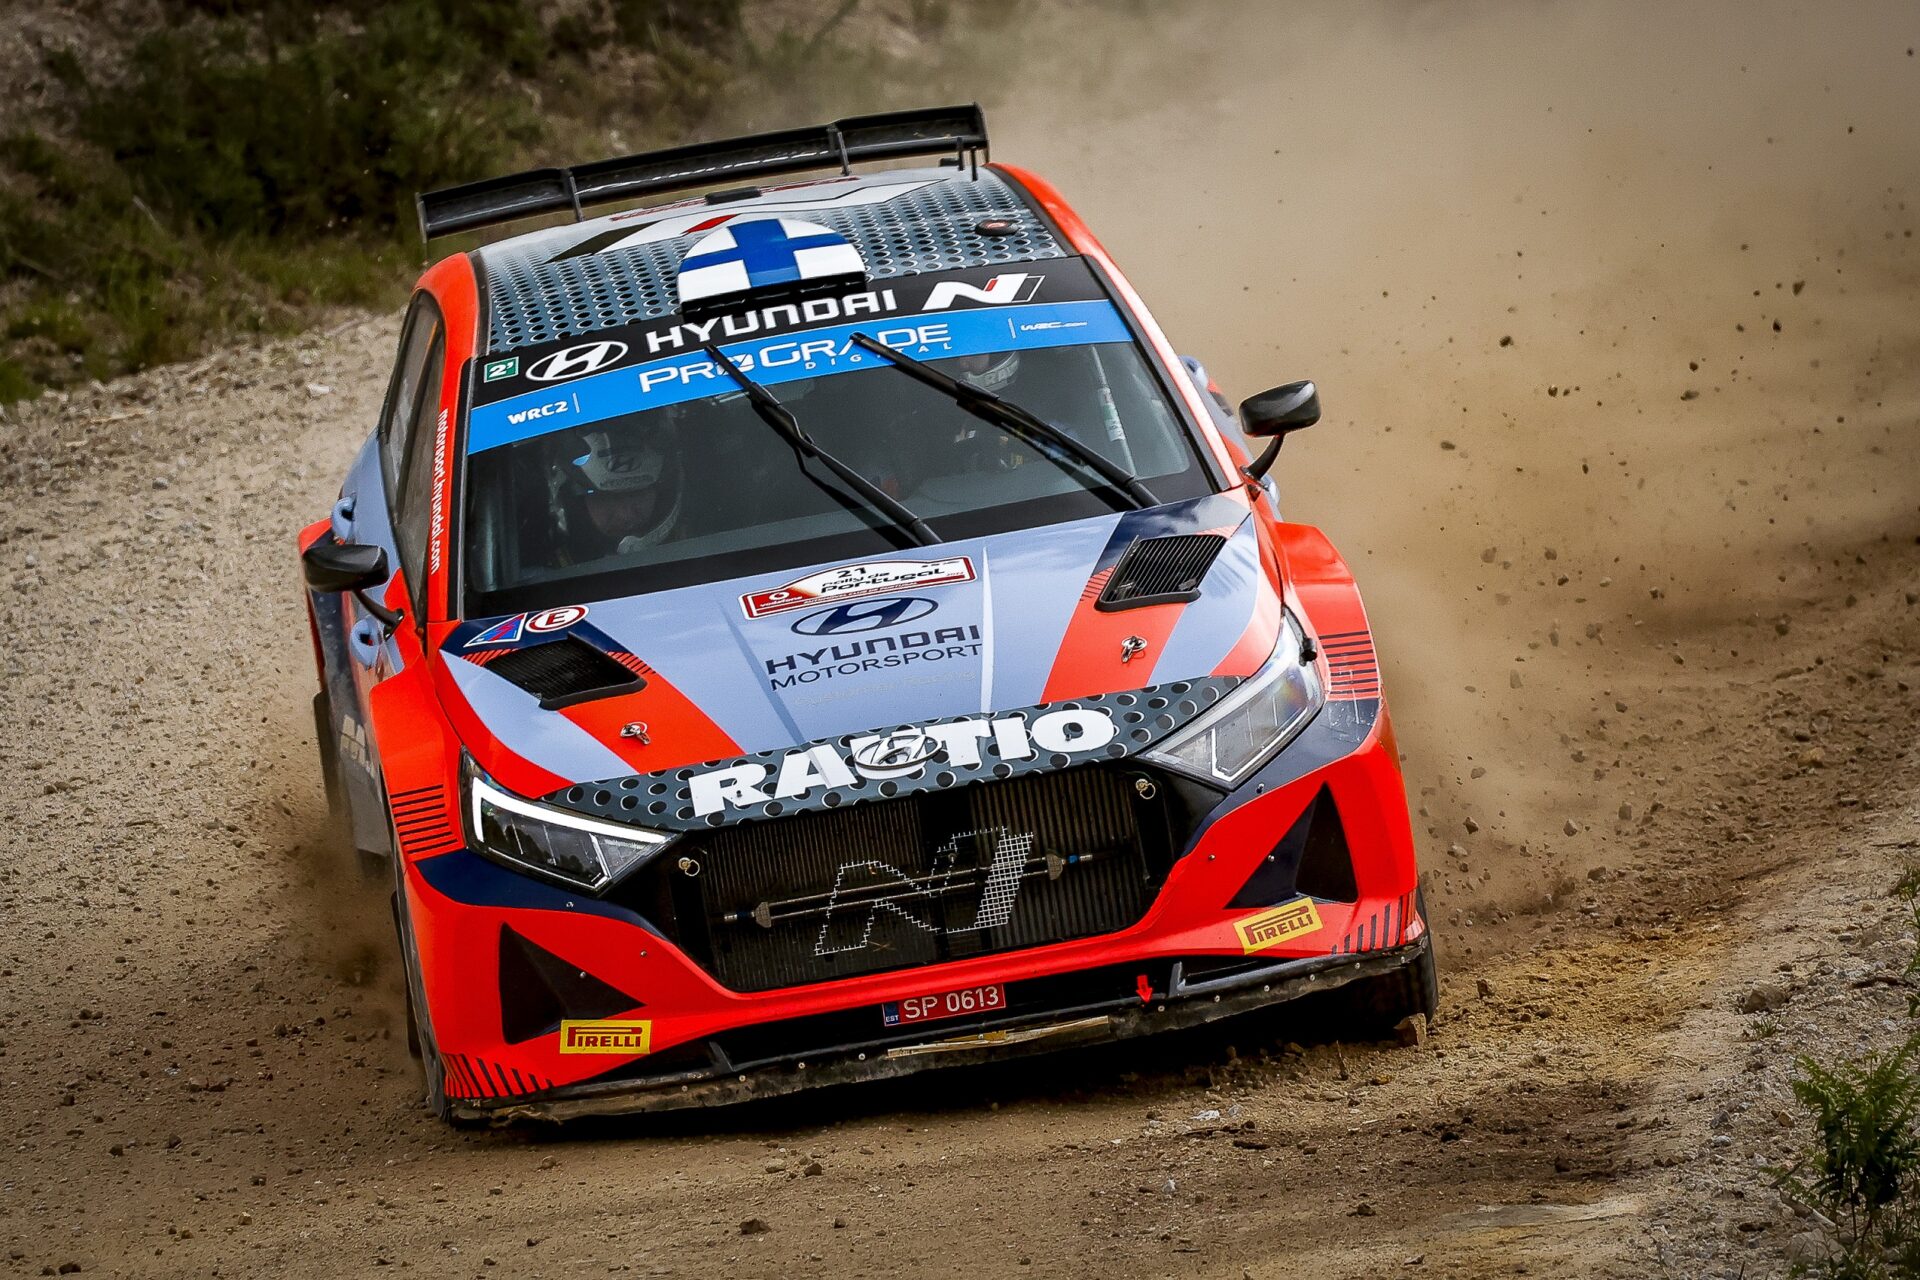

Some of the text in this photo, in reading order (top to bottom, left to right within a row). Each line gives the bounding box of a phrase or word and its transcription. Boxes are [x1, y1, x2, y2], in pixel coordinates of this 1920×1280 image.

[646, 289, 898, 354] HYUNDAI
[805, 342, 953, 370] DIGAL
[507, 401, 569, 425] WRC2
[820, 568, 946, 594] Portugal
[822, 571, 890, 587] rally de
[836, 566, 867, 579] 21
[760, 595, 803, 607] vodafone
[545, 610, 570, 626] E
[765, 625, 980, 675] HYUNDAI
[770, 644, 982, 691] MOTORSPORT
[689, 709, 1115, 817] RAUTIO
[1243, 906, 1314, 946] PIRELLI
[903, 986, 999, 1018] SP 0613
[567, 1027, 643, 1047] PIRELLI
